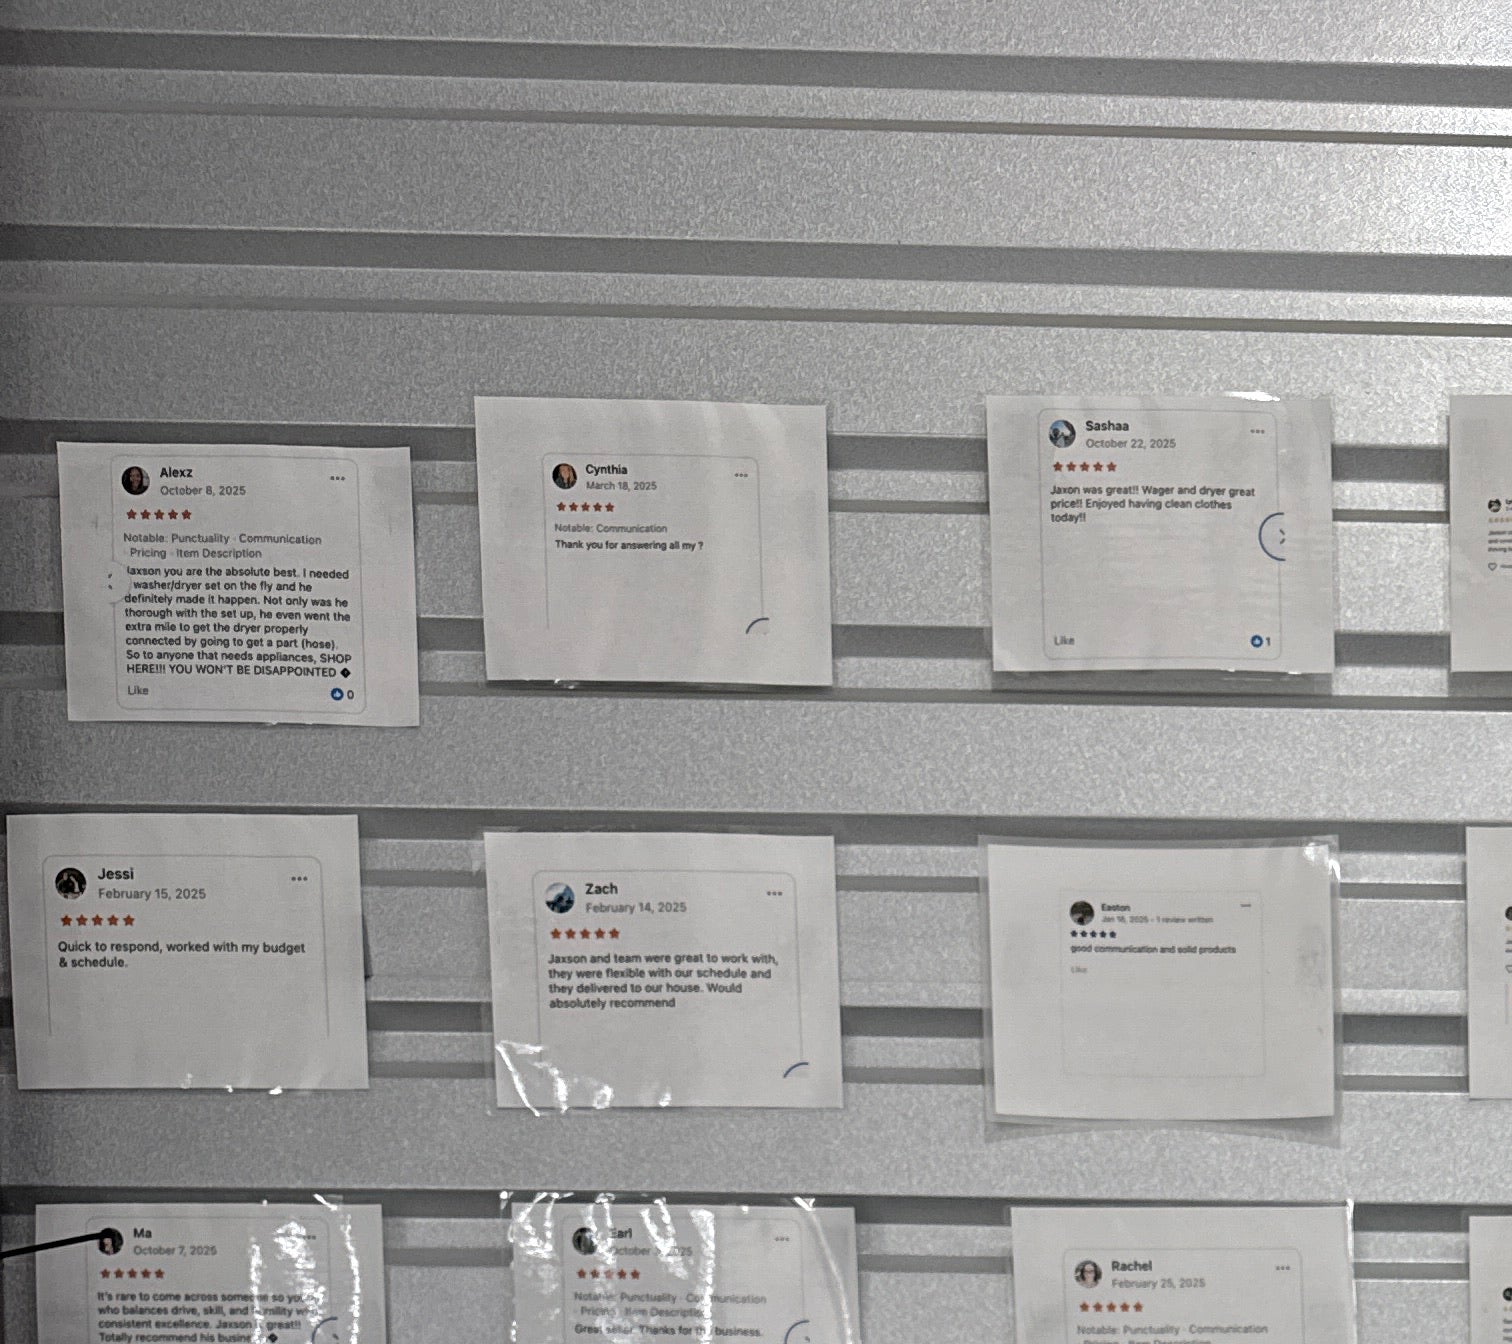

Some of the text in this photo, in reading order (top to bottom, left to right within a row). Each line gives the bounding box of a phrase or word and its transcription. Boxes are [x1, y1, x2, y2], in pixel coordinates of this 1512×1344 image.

[1085, 419, 1129, 432] Sashaa
[1085, 437, 1176, 450] October 22, 2025
[159, 465, 192, 479] Alexz
[585, 463, 628, 477] Cynthia
[159, 484, 246, 497] October 8, 2025
[586, 480, 657, 492] March 18, 2025
[1050, 498, 1232, 511] price!! Enjoyed having clean clothes
[554, 523, 668, 534] Notable: Communication
[554, 539, 703, 552] Thank you for answering all my ?
[126, 663, 337, 678] HERE!!! YOU WON'T BE DISAPPOINTED
[97, 867, 134, 880] Jessi
[98, 887, 206, 902] February 15, 2025
[584, 882, 618, 895] Zach
[585, 901, 687, 915] February 14, 2025
[57, 940, 305, 956] Quick to respond, worked with my budget
[58, 956, 128, 968] & schedule.
[549, 997, 676, 1010] absolutely recommend
[133, 1227, 152, 1238] Ma
[132, 1244, 217, 1257] October 7, 2025
[1111, 1260, 1152, 1272] Rachel
